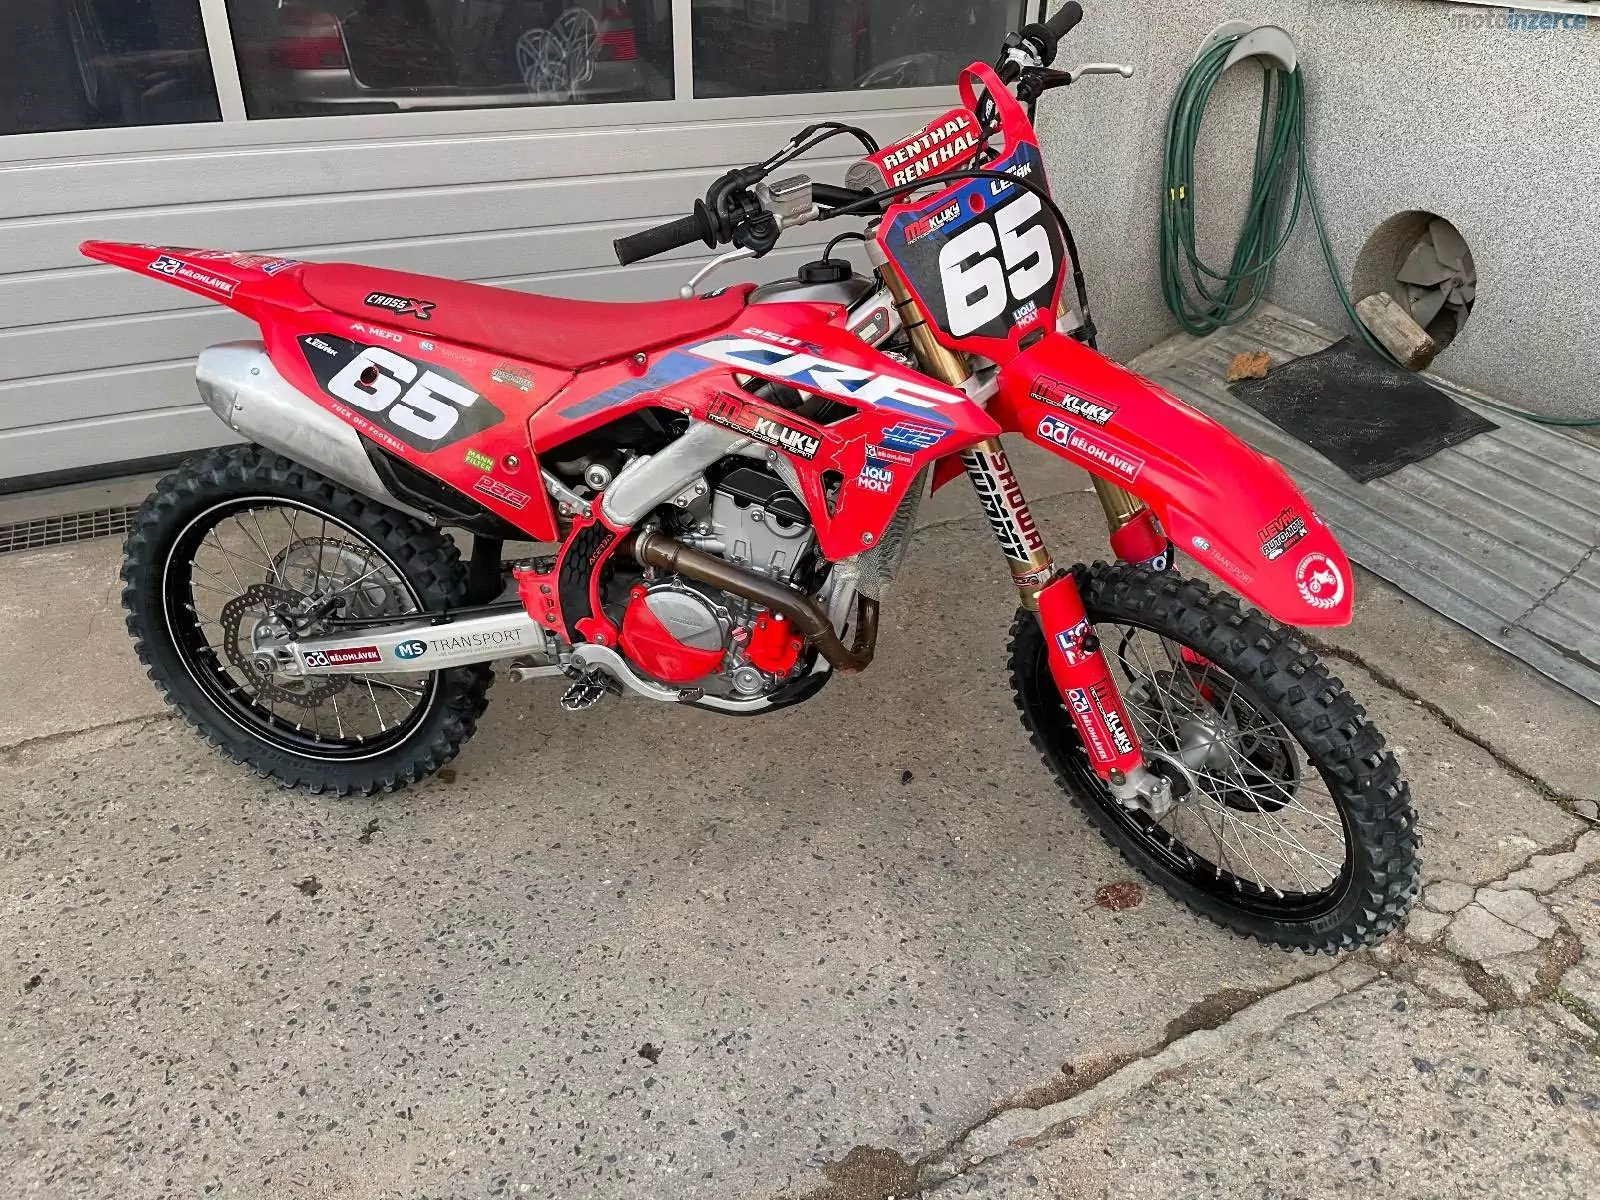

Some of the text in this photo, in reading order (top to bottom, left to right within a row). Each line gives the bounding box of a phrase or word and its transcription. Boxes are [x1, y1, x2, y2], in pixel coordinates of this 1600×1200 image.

[882, 115, 971, 170] RENTHAL
[892, 129, 980, 187] RENTHAL
[939, 191, 1053, 337] 65
[1011, 300, 1036, 321] LIQUI
[1016, 308, 1038, 330] MOLY
[368, 327, 403, 343] MEFO
[742, 327, 824, 355] 250R
[688, 338, 968, 408] CRF
[328, 346, 480, 440] 65
[1061, 394, 1114, 422] KLUKY
[331, 403, 406, 452] FUCK OFF FOOTBALL
[754, 417, 820, 454] KLUKY
[464, 456, 492, 472] FILTER
[467, 449, 494, 466] MANN
[857, 477, 892, 494] MOLY
[990, 451, 1044, 552] SHOWA
[398, 642, 424, 657] MS
[430, 628, 522, 652] TRANSPORT
